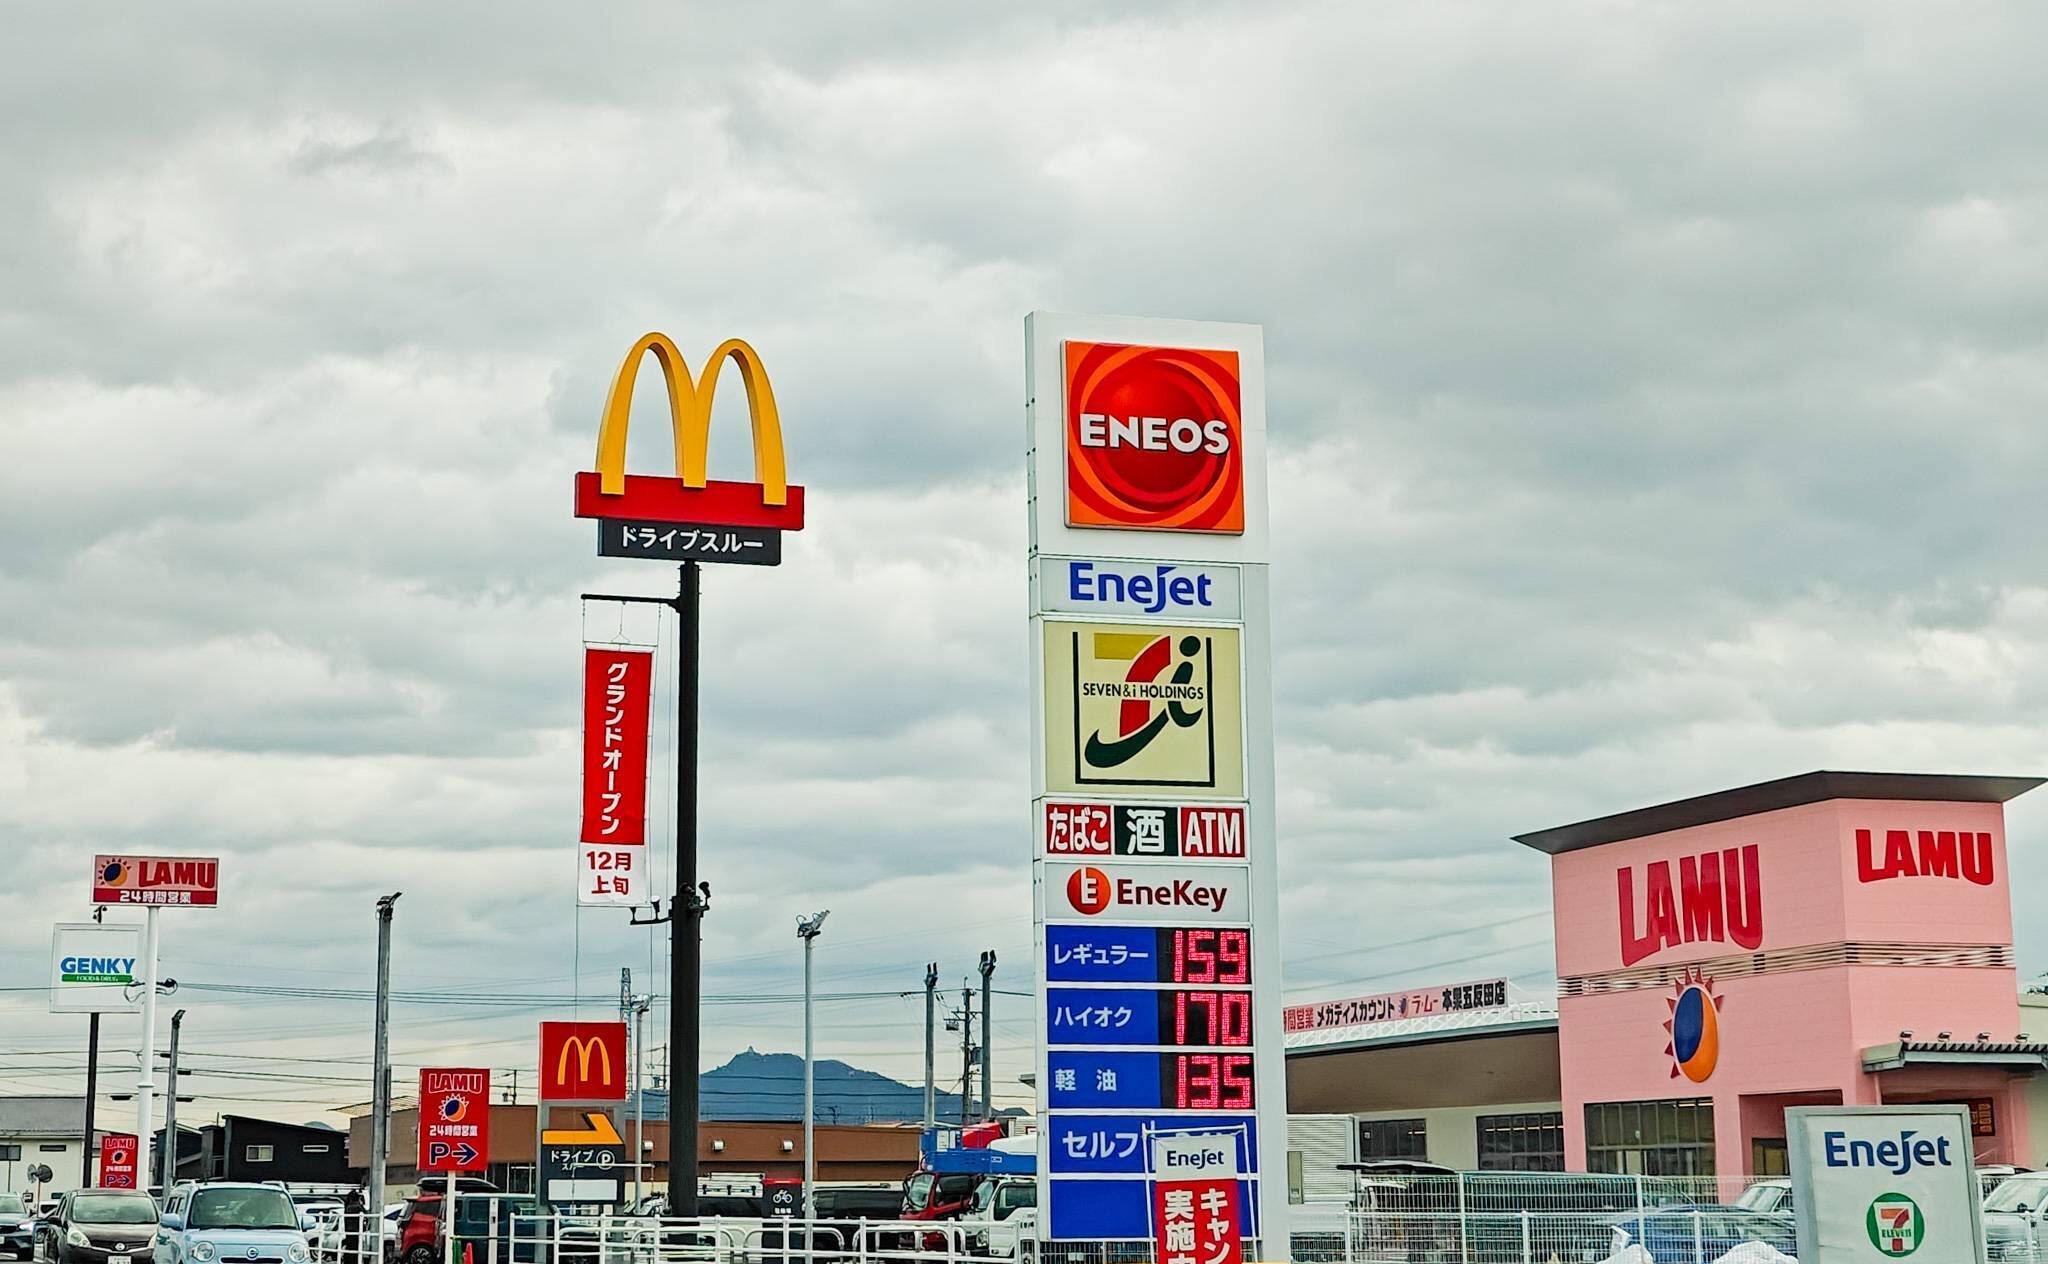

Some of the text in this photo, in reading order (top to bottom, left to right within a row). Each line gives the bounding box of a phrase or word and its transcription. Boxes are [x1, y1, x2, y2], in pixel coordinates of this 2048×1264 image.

[1080, 413, 1230, 455] ENEOS
[622, 525, 764, 553] ドライブスルー
[1140, 684, 1204, 700] HOLDINGS
[601, 662, 628, 836] グランドオープン
[1049, 806, 1109, 852] たばこ
[1126, 808, 1166, 855] 酒
[1185, 811, 1241, 854] ATM
[586, 850, 632, 872] 12月
[1856, 829, 1994, 886] LAMU
[138, 861, 216, 889] LAMU
[591, 875, 629, 896] 上旬
[1117, 879, 1227, 912] EneKey
[1617, 844, 1763, 967] LAMU
[60, 956, 136, 974] GENKY
[1054, 943, 1149, 965] レギュラー
[1173, 929, 1248, 983] 159
[1054, 1006, 1132, 1027] ハイオク
[1175, 992, 1249, 1045] 170
[1284, 1006, 1314, 1033] 間営業
[1317, 997, 1395, 1027] メガディスカウント
[428, 1073, 482, 1094] LAMU
[1177, 1055, 1250, 1108] 135
[551, 1149, 594, 1163] ドライブ
[1062, 1130, 1139, 1159] セルフ
